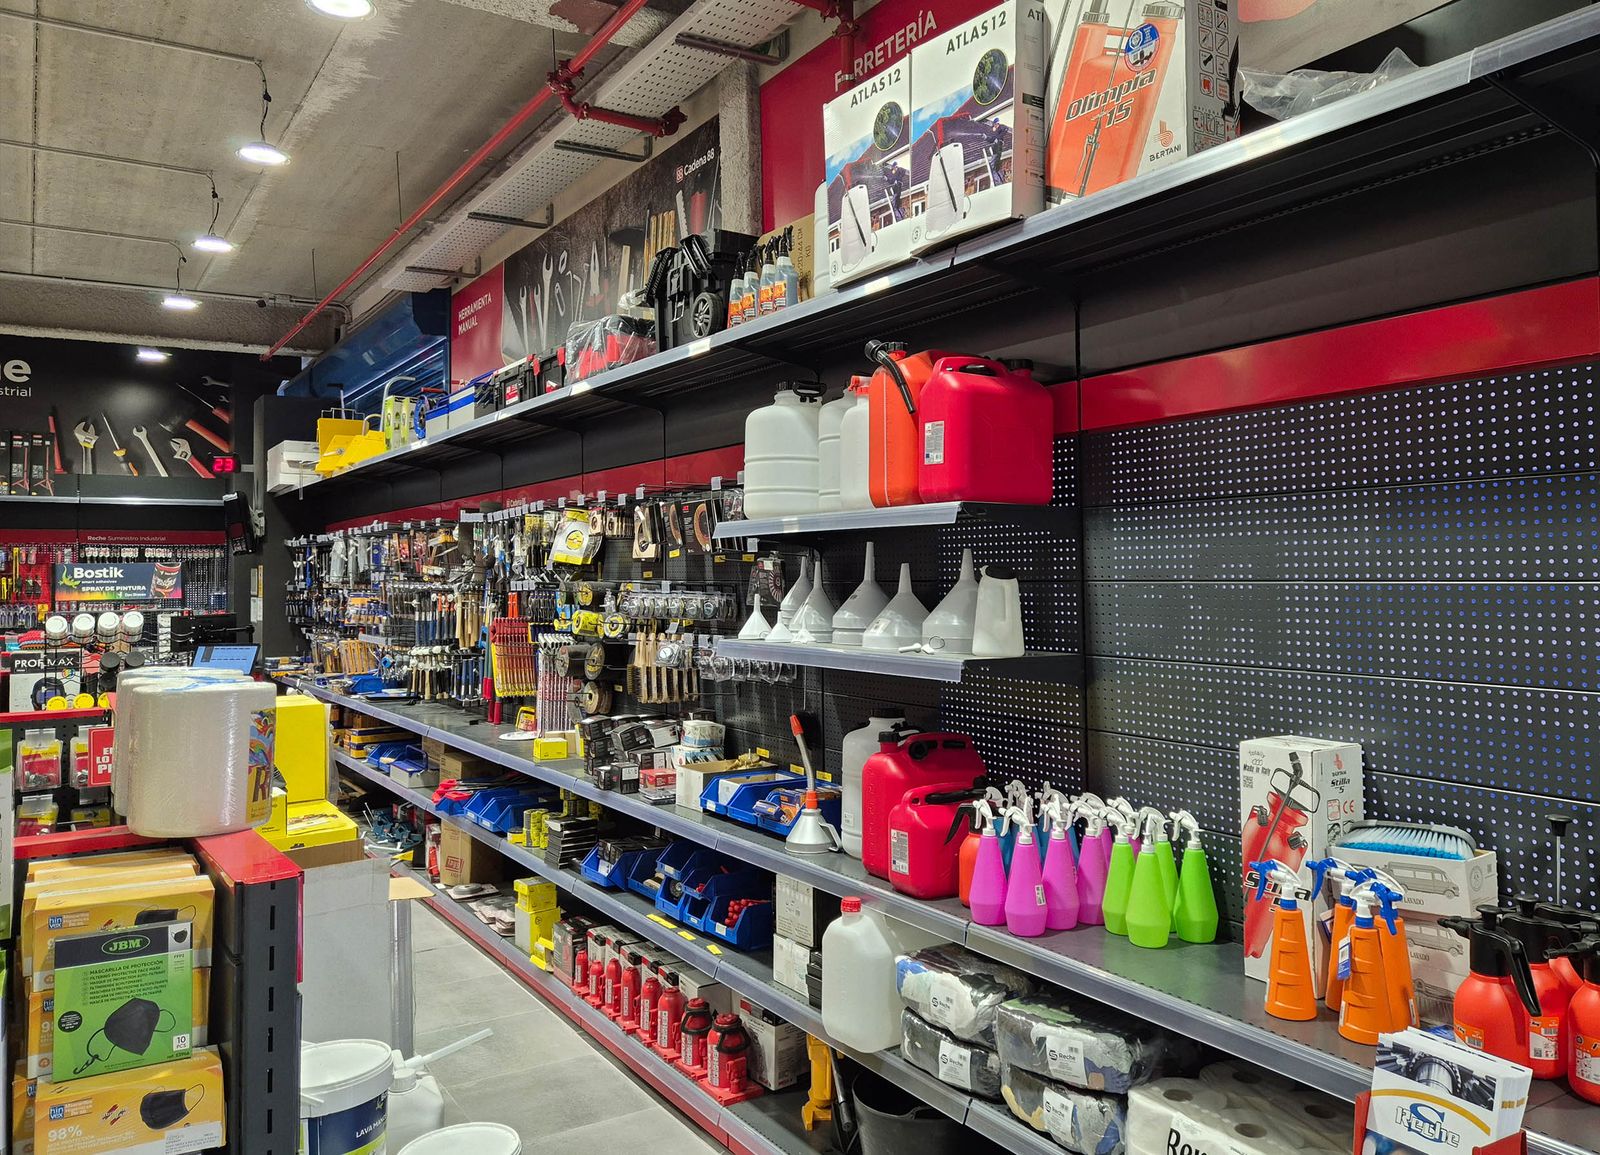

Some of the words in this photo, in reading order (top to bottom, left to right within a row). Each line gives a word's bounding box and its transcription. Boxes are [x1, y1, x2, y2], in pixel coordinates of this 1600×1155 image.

[1065, 69, 1157, 122] Olimpia
[1149, 144, 1181, 162] BERTANI
[684, 155, 707, 176] Cadena
[707, 148, 715, 161] 88
[458, 292, 492, 322] HERRAMIENTA
[458, 315, 478, 336] MANUAL
[213, 458, 233, 472] 23
[73, 567, 124, 579] Bostik
[1330, 777, 1351, 788] Stilla
[109, 939, 141, 952] JBM
[90, 966, 122, 975] MASCARILLA
[130, 960, 163, 969] PROTECCIÓN
[177, 1036, 187, 1044] 10
[48, 1125, 82, 1142] 98%
[356, 1125, 373, 1139] LAVA
